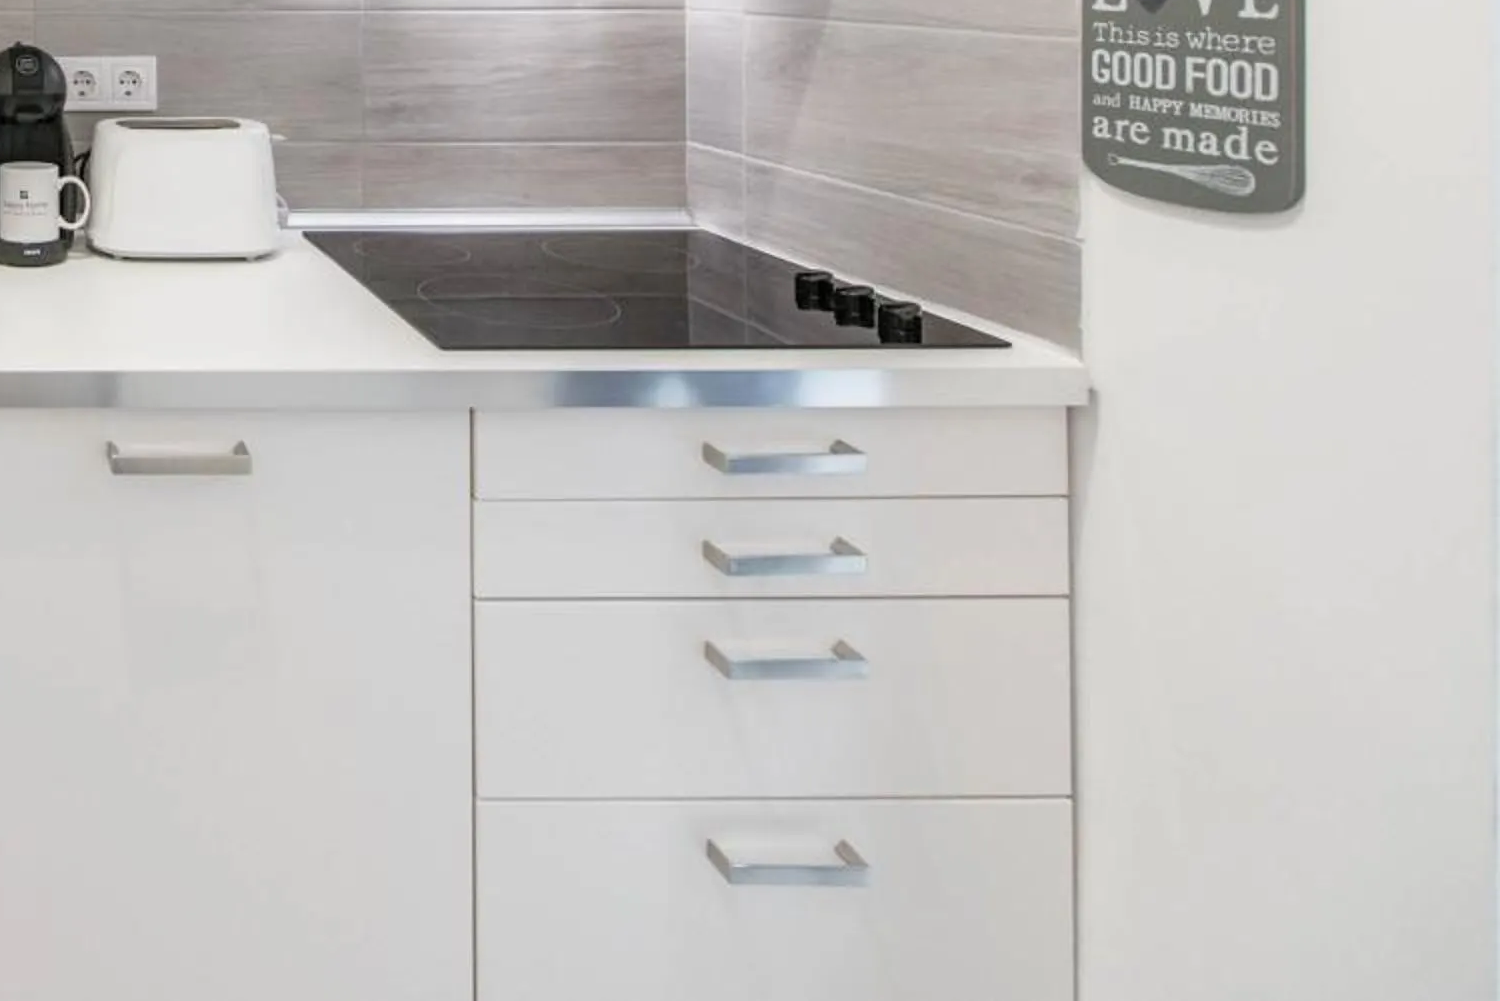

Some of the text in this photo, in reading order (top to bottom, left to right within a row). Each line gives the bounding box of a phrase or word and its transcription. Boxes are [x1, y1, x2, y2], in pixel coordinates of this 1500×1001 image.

[1092, 22, 1276, 55] This is where
[1091, 49, 1279, 102] GOOD FOOD
[1093, 93, 1282, 128] and HAPPY MEMORIES
[1092, 115, 1279, 165] are made
